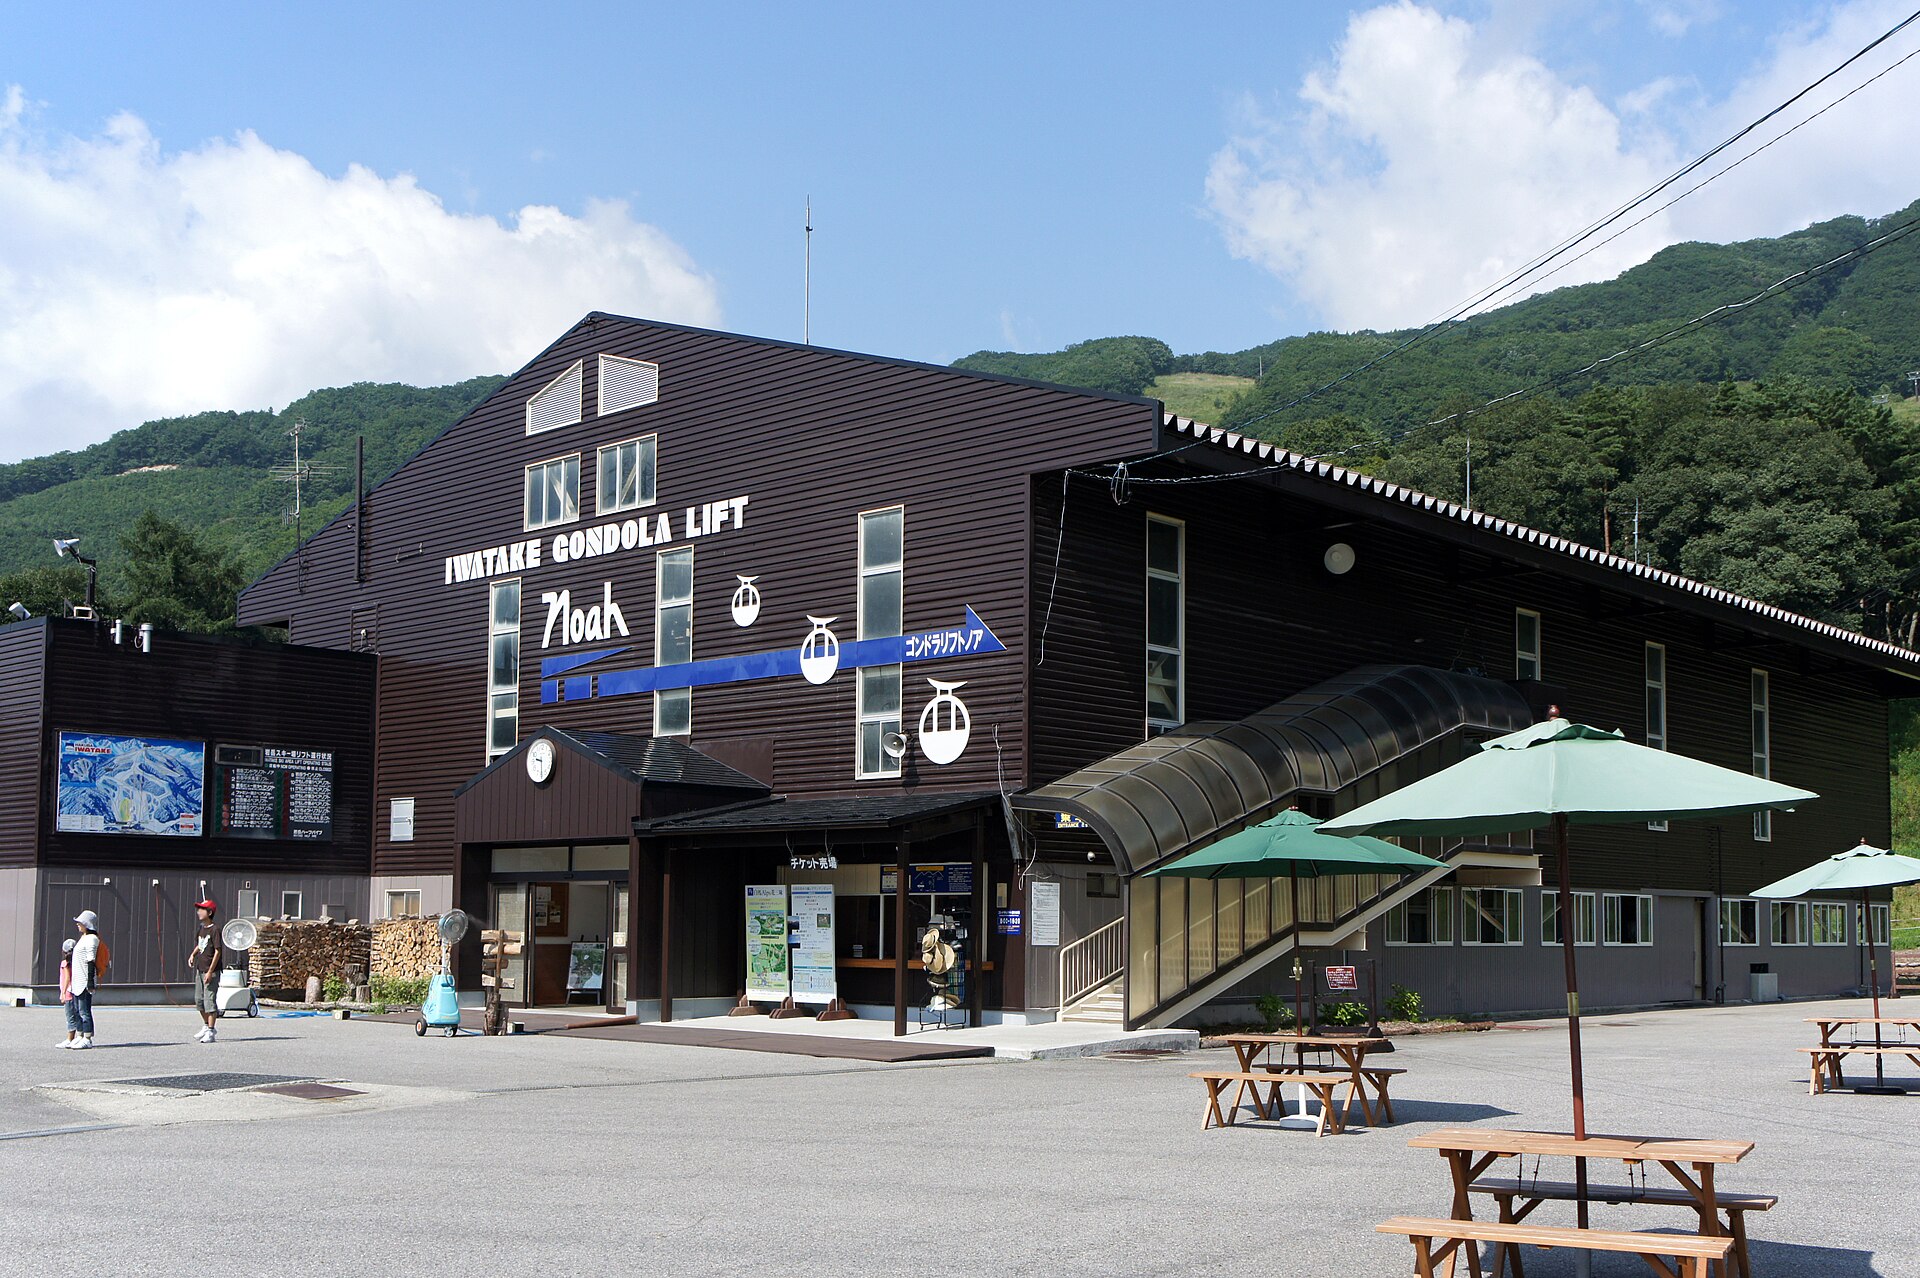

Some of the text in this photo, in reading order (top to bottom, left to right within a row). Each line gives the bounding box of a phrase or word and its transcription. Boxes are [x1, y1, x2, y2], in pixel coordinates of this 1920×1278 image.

[445, 495, 749, 585] IWATAKE GONDOLA LIFT
[541, 581, 630, 649] Noah
[905, 629, 984, 658] ゴンドラリフトノア
[790, 857, 838, 869] チケット売場
